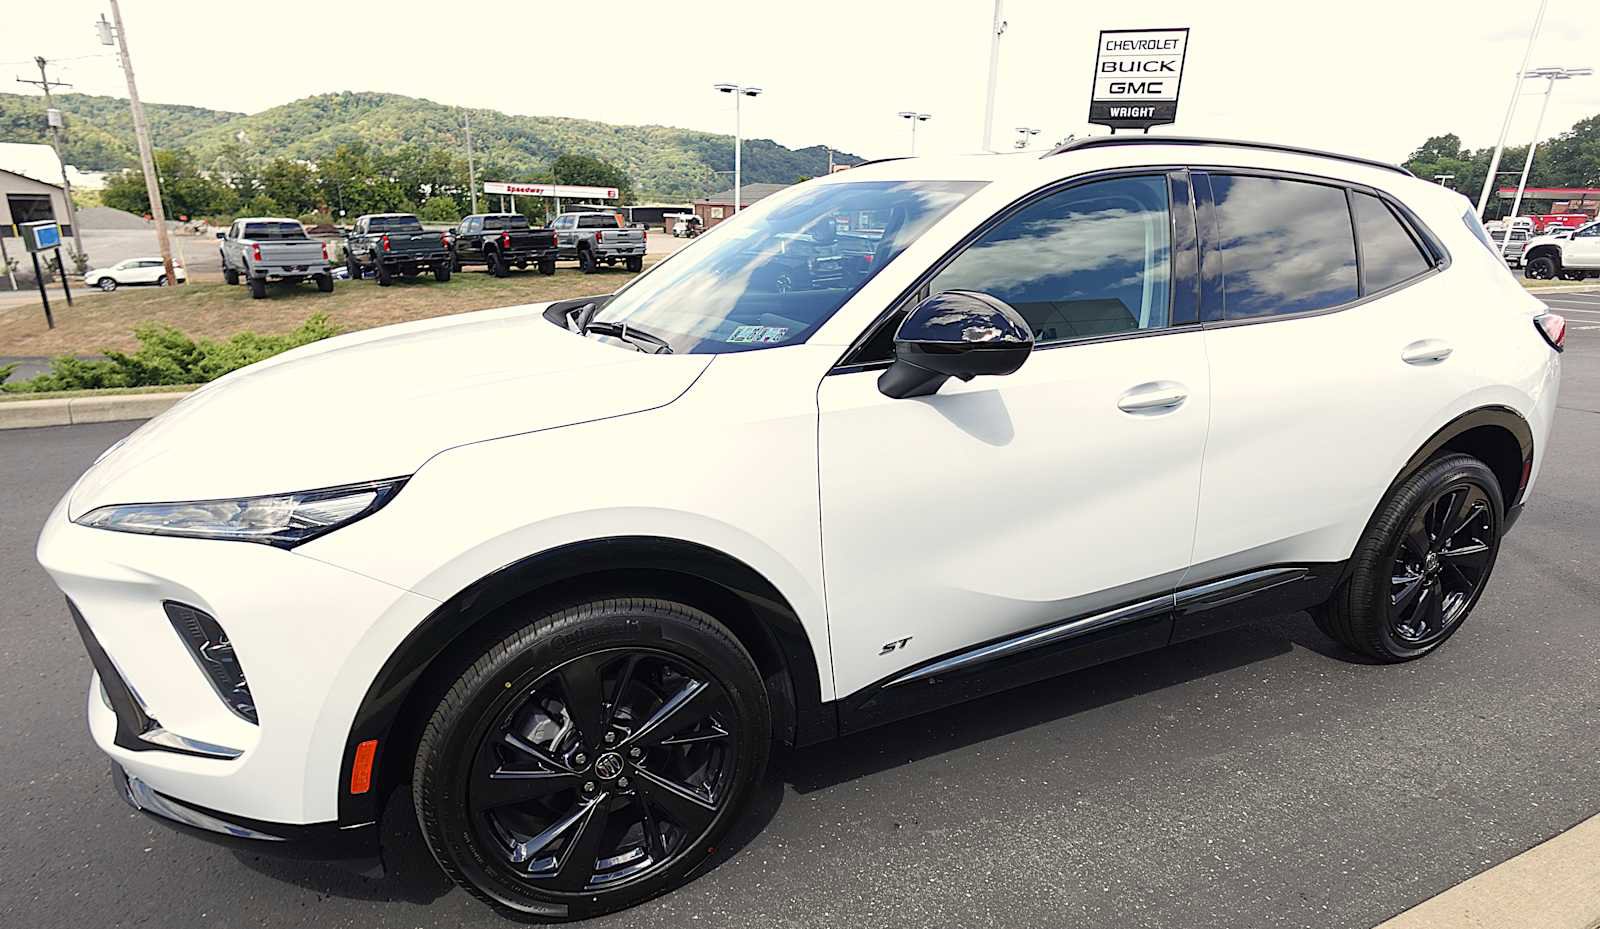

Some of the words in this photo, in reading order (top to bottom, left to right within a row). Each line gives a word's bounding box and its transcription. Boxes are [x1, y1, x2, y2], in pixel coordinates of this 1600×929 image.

[1106, 39, 1180, 51] CHEVROLET
[1101, 60, 1176, 72] BUICK
[1109, 82, 1164, 94] GMC
[1110, 107, 1156, 117] WRIGHT
[506, 185, 545, 195] Speedway
[878, 636, 913, 656] ST
